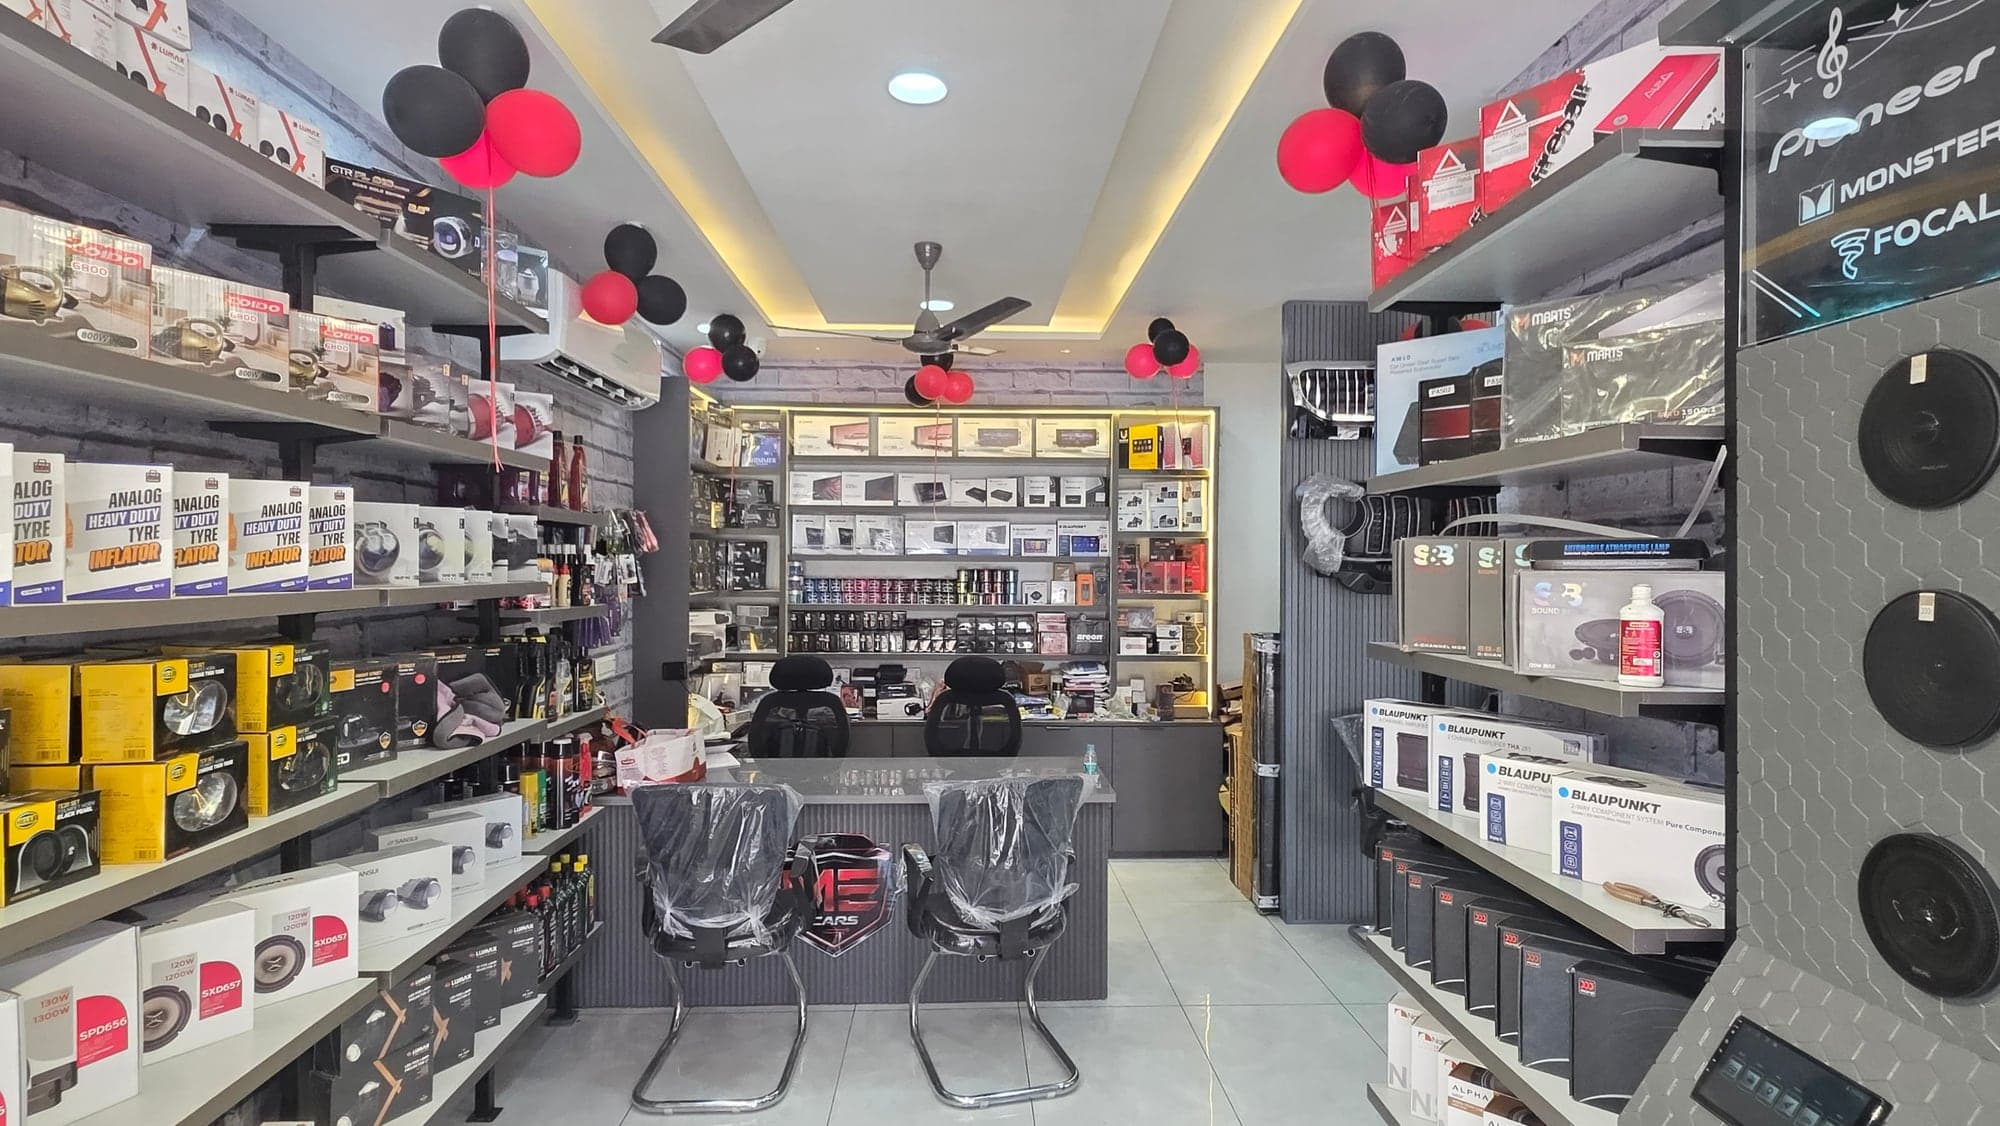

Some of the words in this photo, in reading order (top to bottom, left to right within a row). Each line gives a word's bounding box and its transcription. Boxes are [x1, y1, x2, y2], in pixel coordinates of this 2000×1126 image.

[1840, 119, 2000, 203] MONSTER
[330, 164, 353, 177] GTR
[1873, 193, 2000, 255] FOCAL
[1587, 348, 1623, 362] MARTS
[109, 488, 162, 509] ANALOG
[174, 495, 219, 512] ANALOG
[14, 502, 50, 519] DUTY
[89, 510, 128, 529] HEAVY
[129, 507, 160, 523] DUTY
[261, 501, 302, 518] ANALOG
[309, 504, 346, 520] ANALOG
[190, 512, 218, 528] DUTY
[245, 520, 275, 535] HEAVY
[277, 517, 301, 531] DUTY
[323, 519, 345, 532] DUTY
[14, 520, 50, 540] TYRE
[129, 524, 160, 543] TYRE
[190, 528, 218, 545] TYRE
[322, 531, 345, 546] TYRE
[276, 531, 301, 547] TYRE
[1650, 543, 1670, 552] LAMP
[89, 542, 162, 572] INFLATOR
[245, 545, 302, 571] INFLATOR
[1379, 708, 1428, 722] BLAUPUNKT
[1447, 724, 1506, 740] BLAUPUNKT
[1498, 766, 1552, 784] BLAUPU
[1571, 789, 1661, 815] BLAUPUNKT
[1666, 820, 1683, 830] Pure
[287, 912, 308, 922] 120W
[283, 921, 308, 932] 1200W
[314, 933, 347, 948] SXD657
[170, 958, 195, 969] 120W
[165, 969, 195, 981] 1200W
[201, 980, 241, 998] SXD657
[41, 991, 70, 1008] 130W
[33, 1005, 70, 1024] 1300W
[80, 1016, 127, 1041] SPD656
[1451, 1084, 1489, 1102] ALPHA
